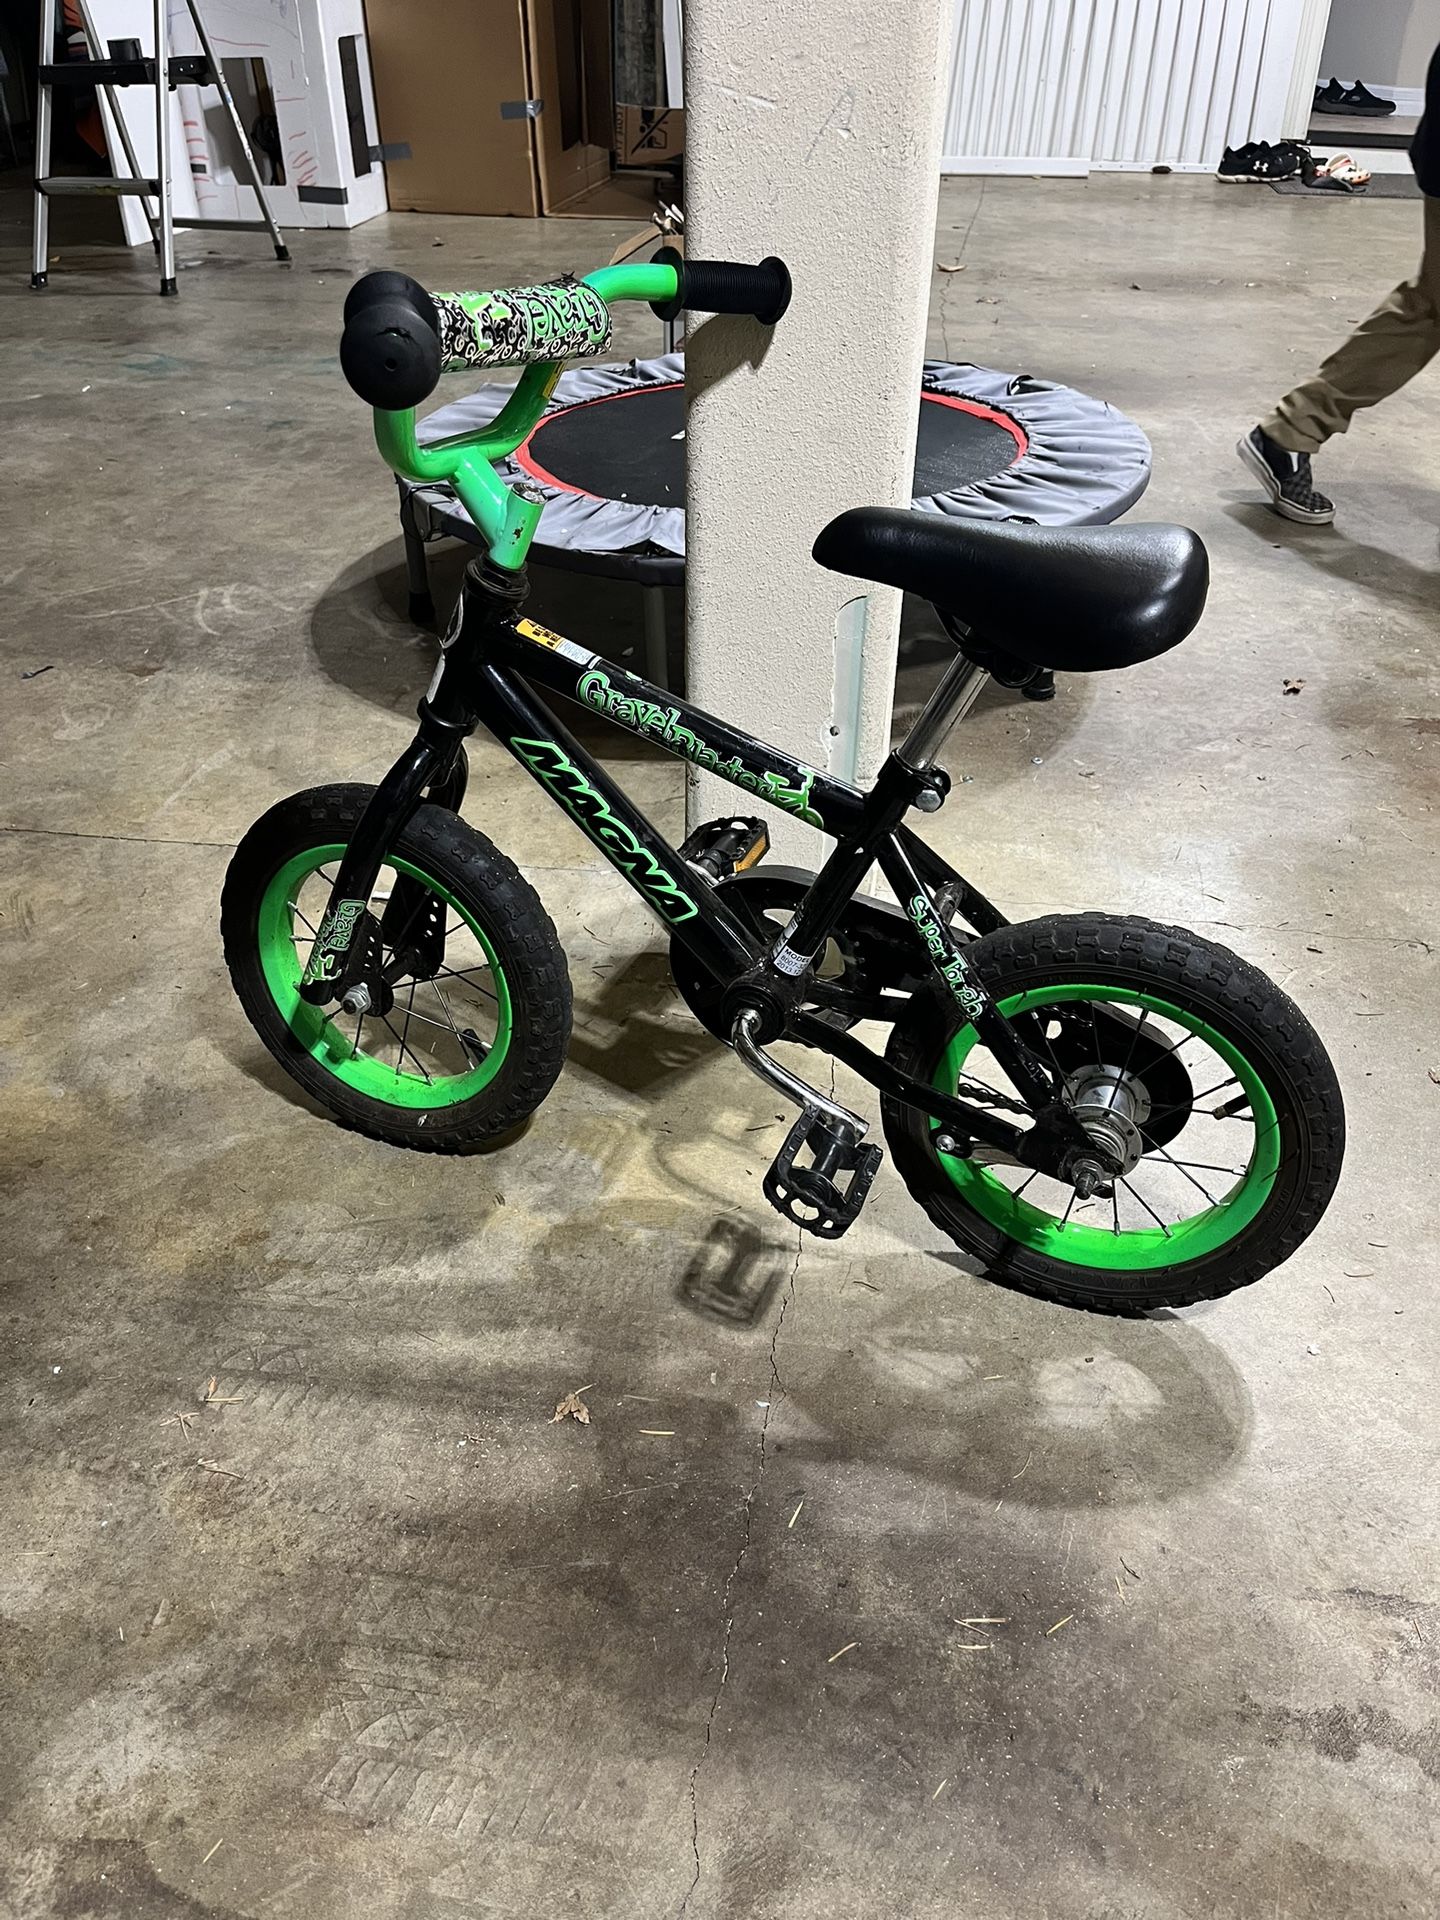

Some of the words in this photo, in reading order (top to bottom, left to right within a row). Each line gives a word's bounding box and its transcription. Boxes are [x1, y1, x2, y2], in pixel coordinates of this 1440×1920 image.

[522, 286, 609, 350] Gravel
[510, 737, 698, 923] MAGNA
[907, 895, 949, 960] Super
[940, 948, 987, 1020] Tough
